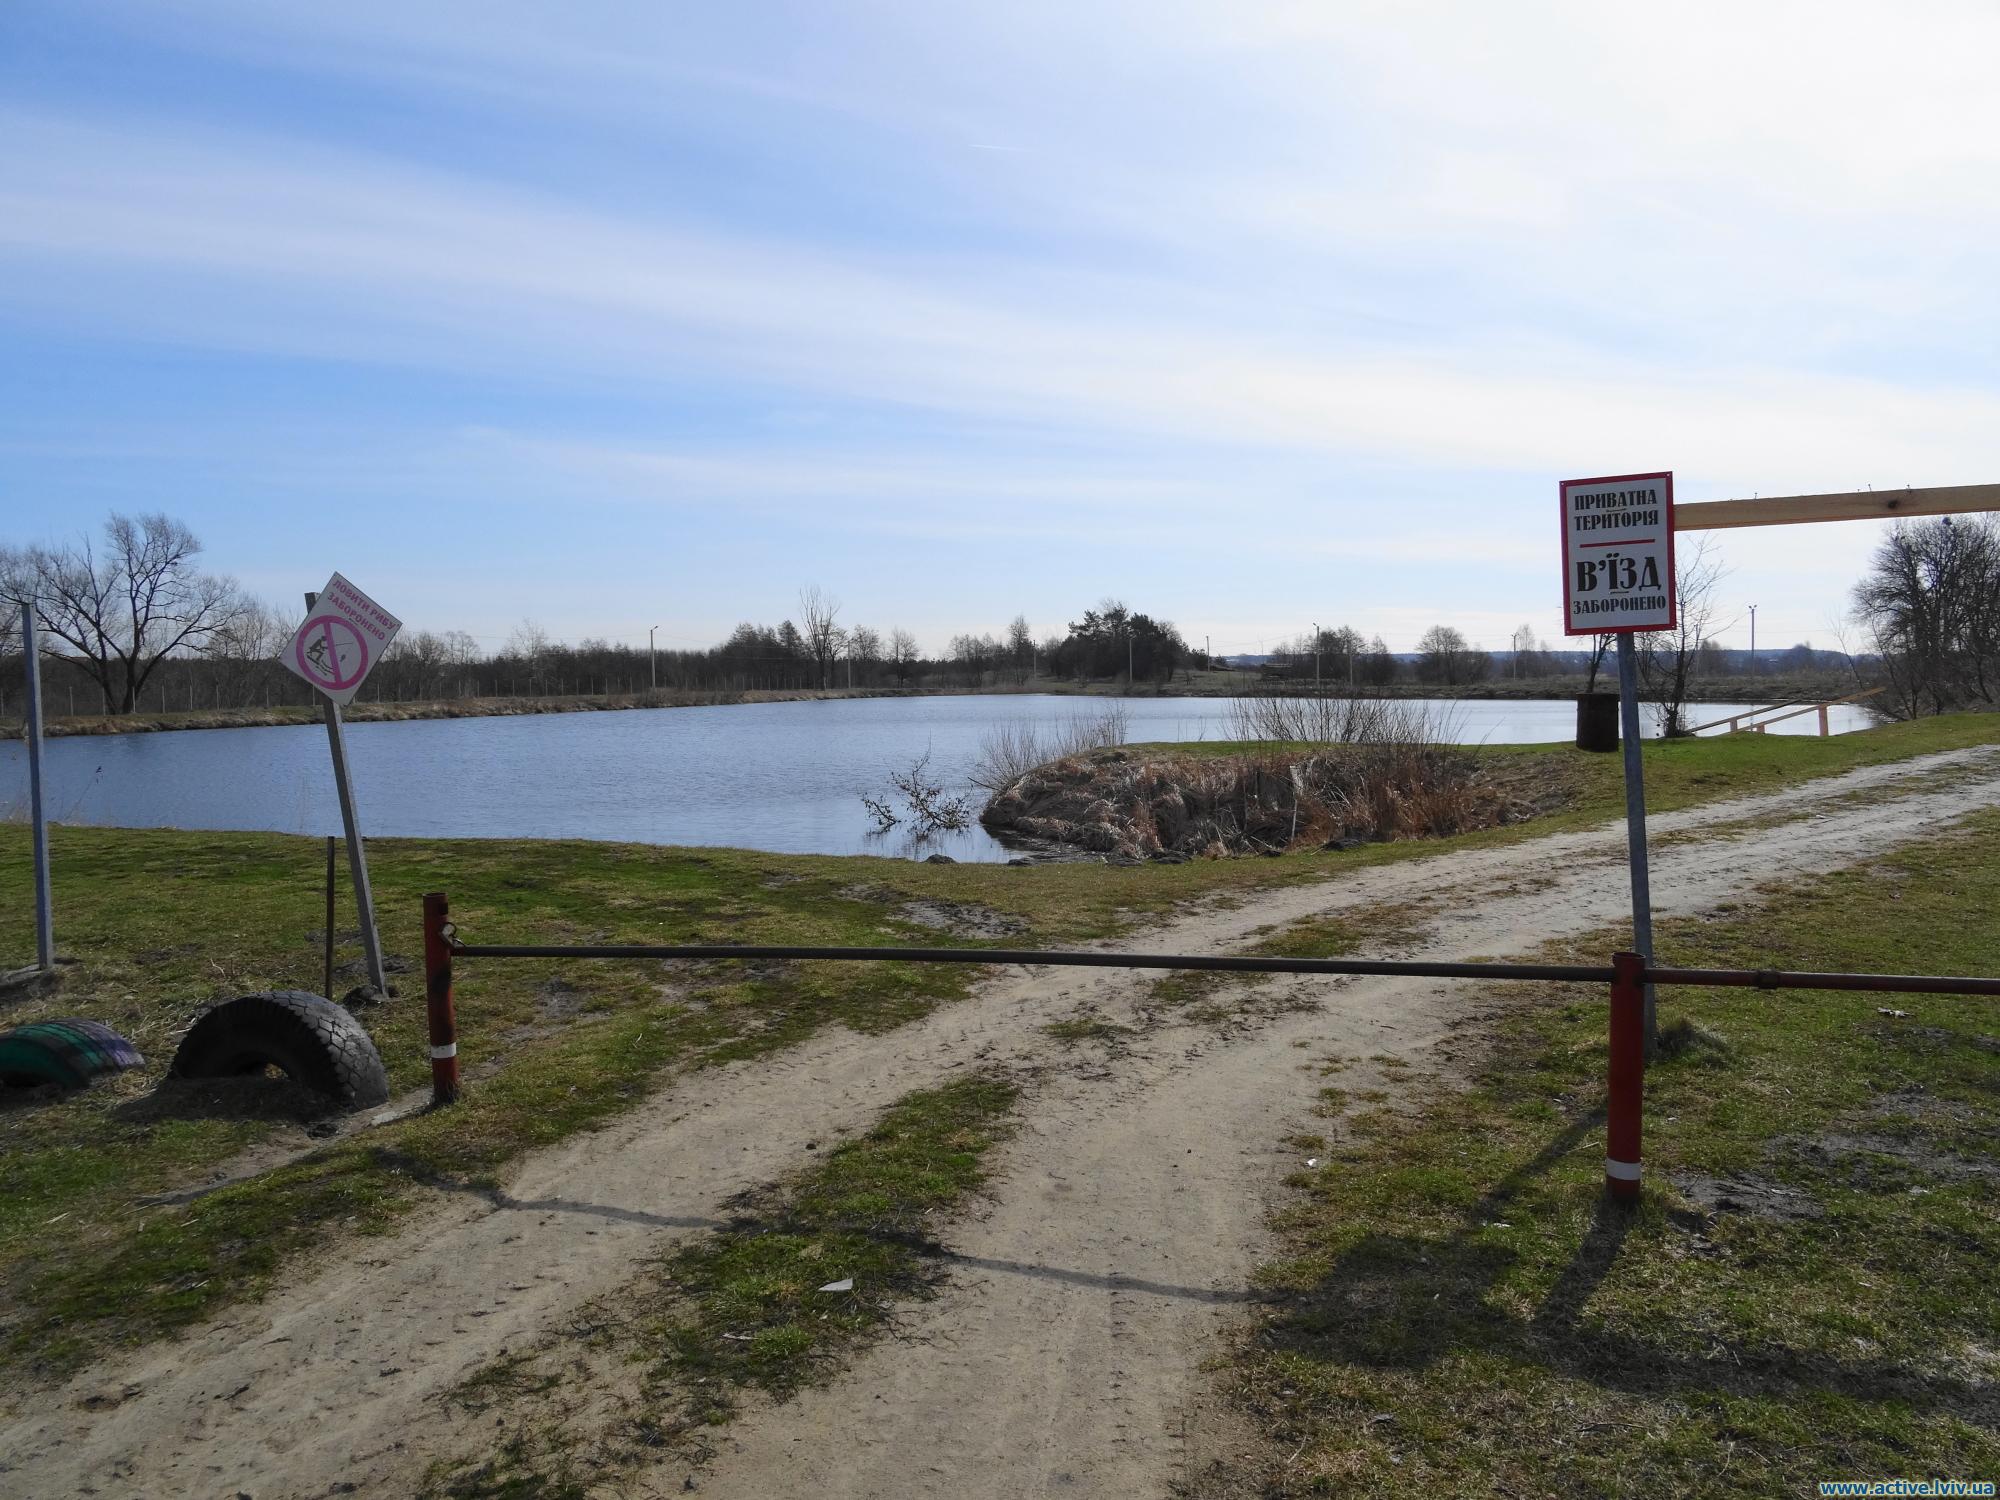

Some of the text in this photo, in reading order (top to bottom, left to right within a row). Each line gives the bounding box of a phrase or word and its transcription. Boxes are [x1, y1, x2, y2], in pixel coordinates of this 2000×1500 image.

[1574, 489, 1658, 511] ПРИВАТНА
[1574, 509, 1659, 531] ТЕРИТОРІЯ
[1576, 552, 1662, 593] В'ЇЗД
[327, 592, 386, 641] ЗАБОРОНЕНО
[333, 579, 396, 630] ЛОВИТИ РИБУ
[1573, 595, 1666, 615] ЗАБОРОНЕНО
